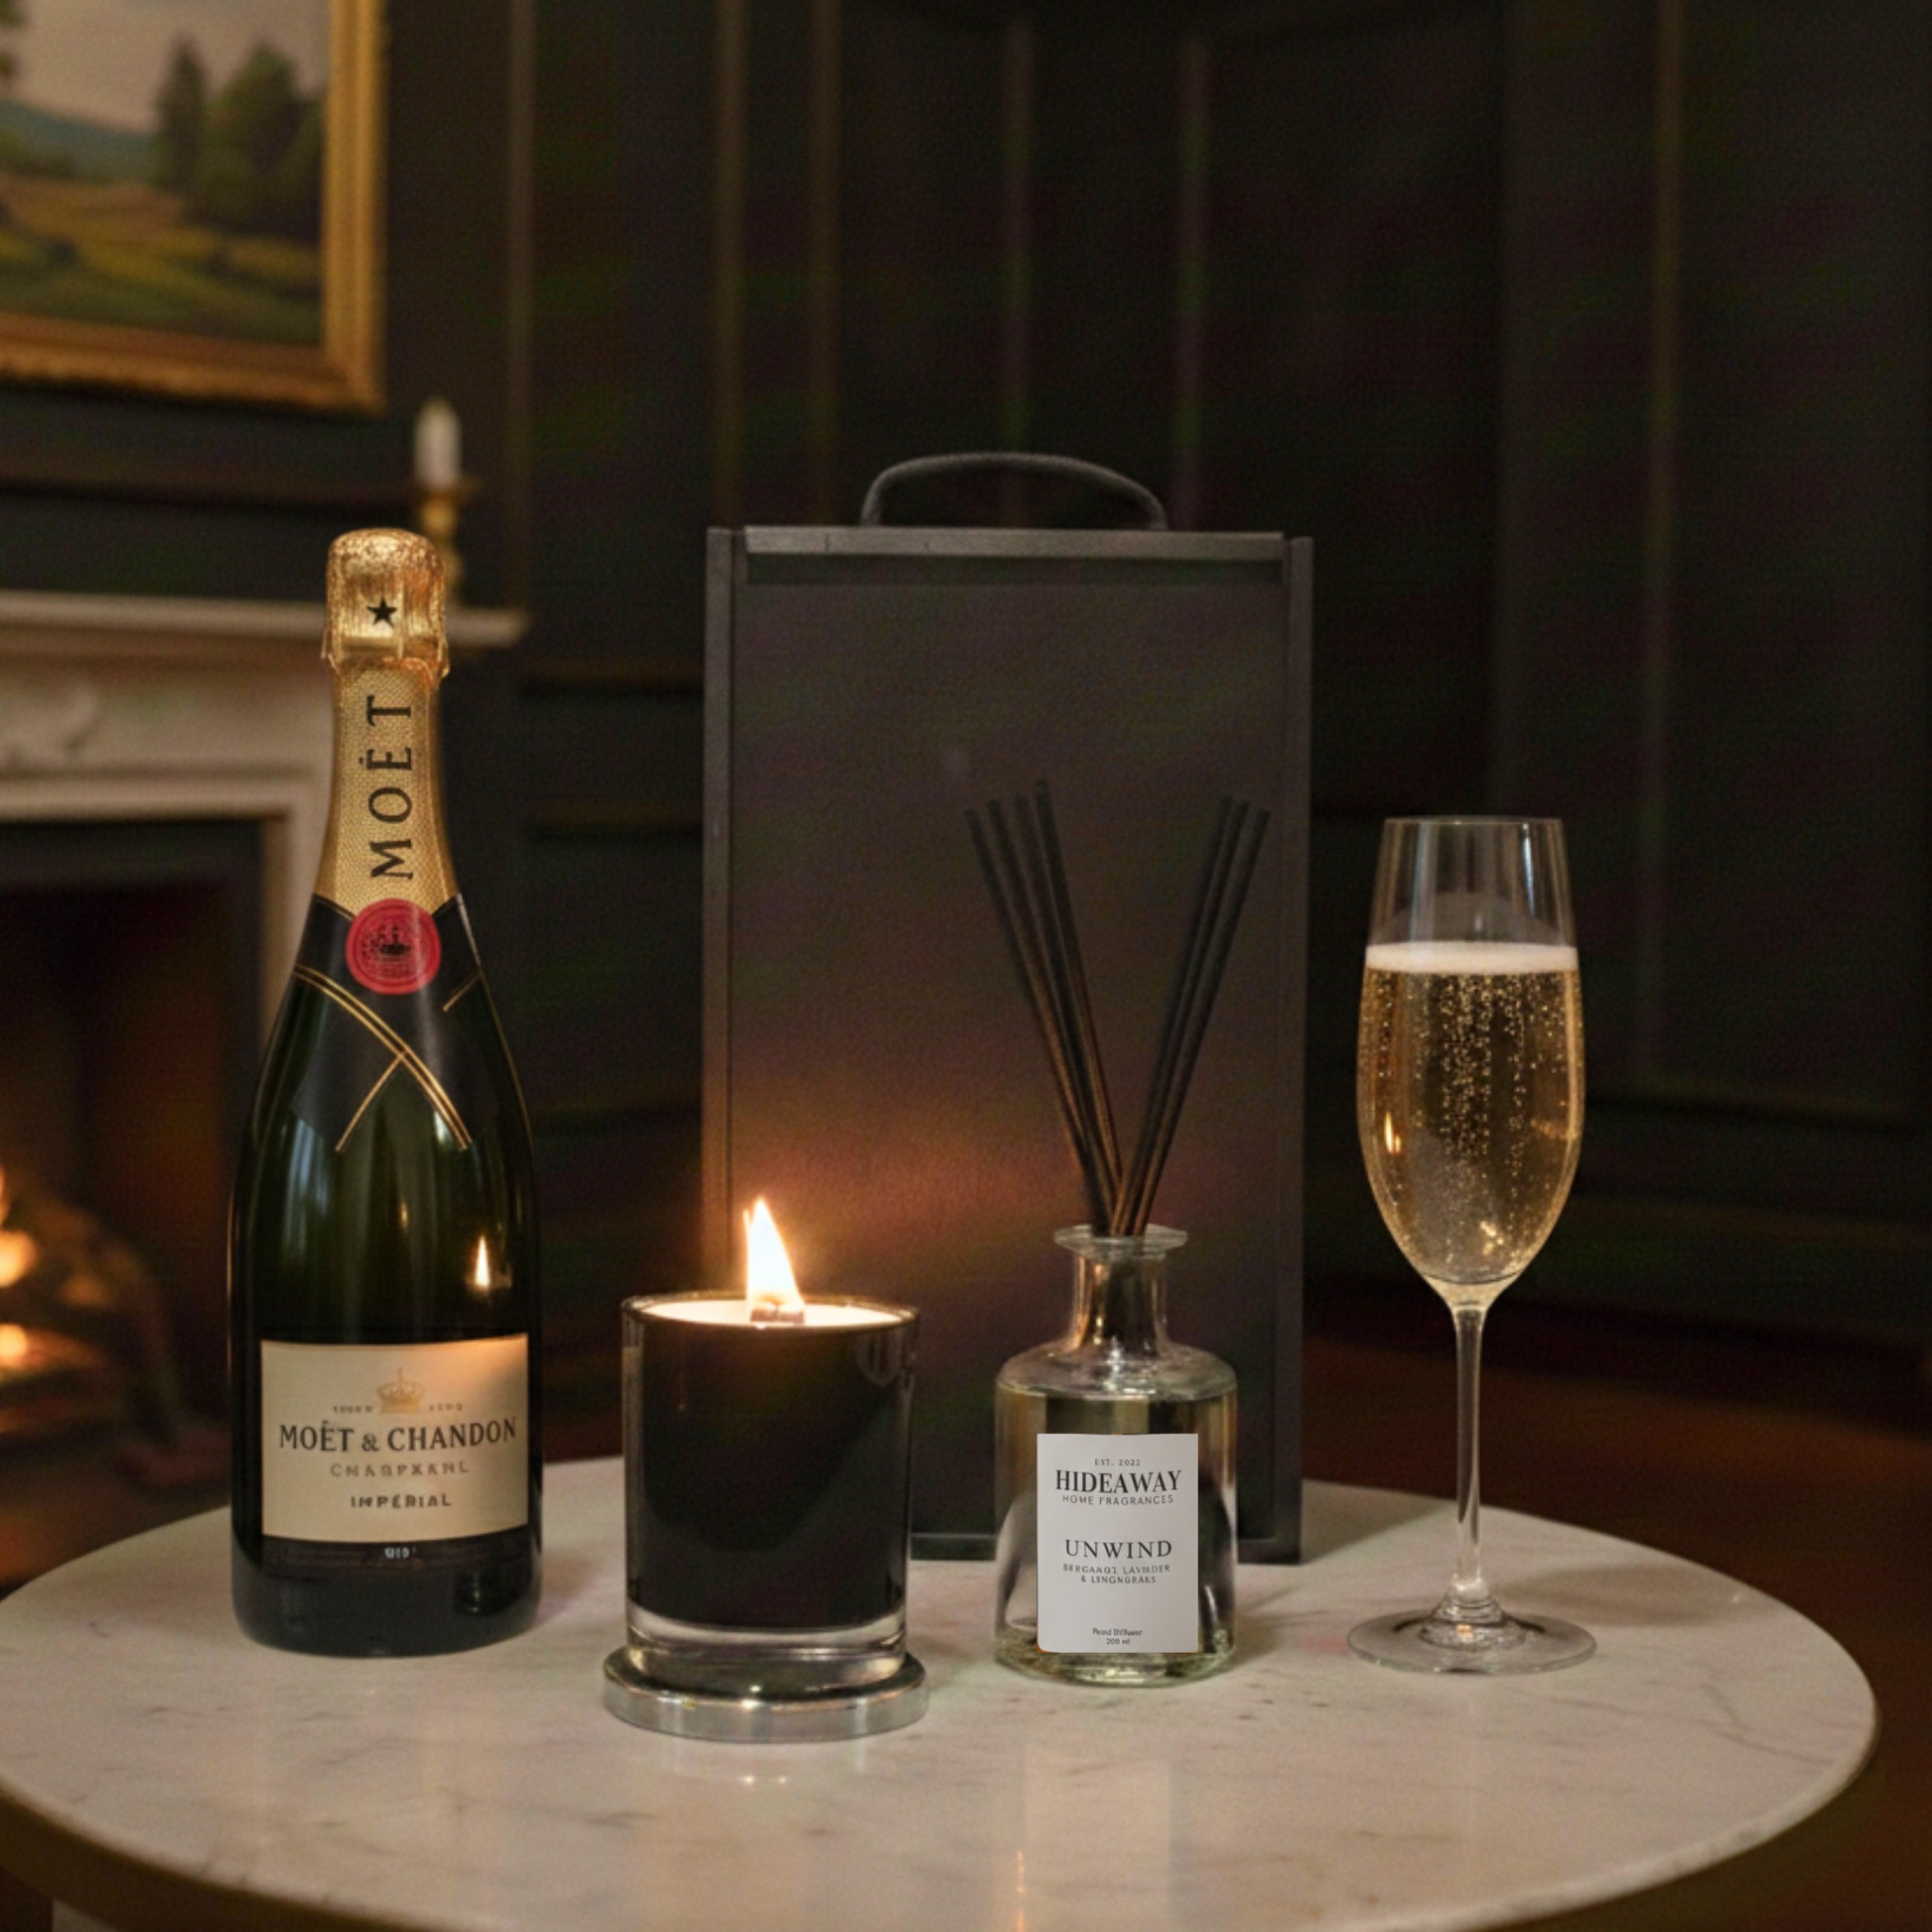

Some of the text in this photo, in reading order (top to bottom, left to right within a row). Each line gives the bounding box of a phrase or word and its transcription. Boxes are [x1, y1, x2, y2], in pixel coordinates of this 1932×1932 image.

[361, 1433, 379, 1452] &
[387, 1416, 517, 1452] CHANDON
[1055, 1469, 1181, 1494] HIDEAWAY
[1062, 1494, 1174, 1506] HOME FRAGRANCES
[1065, 1539, 1173, 1559] UNWIND
